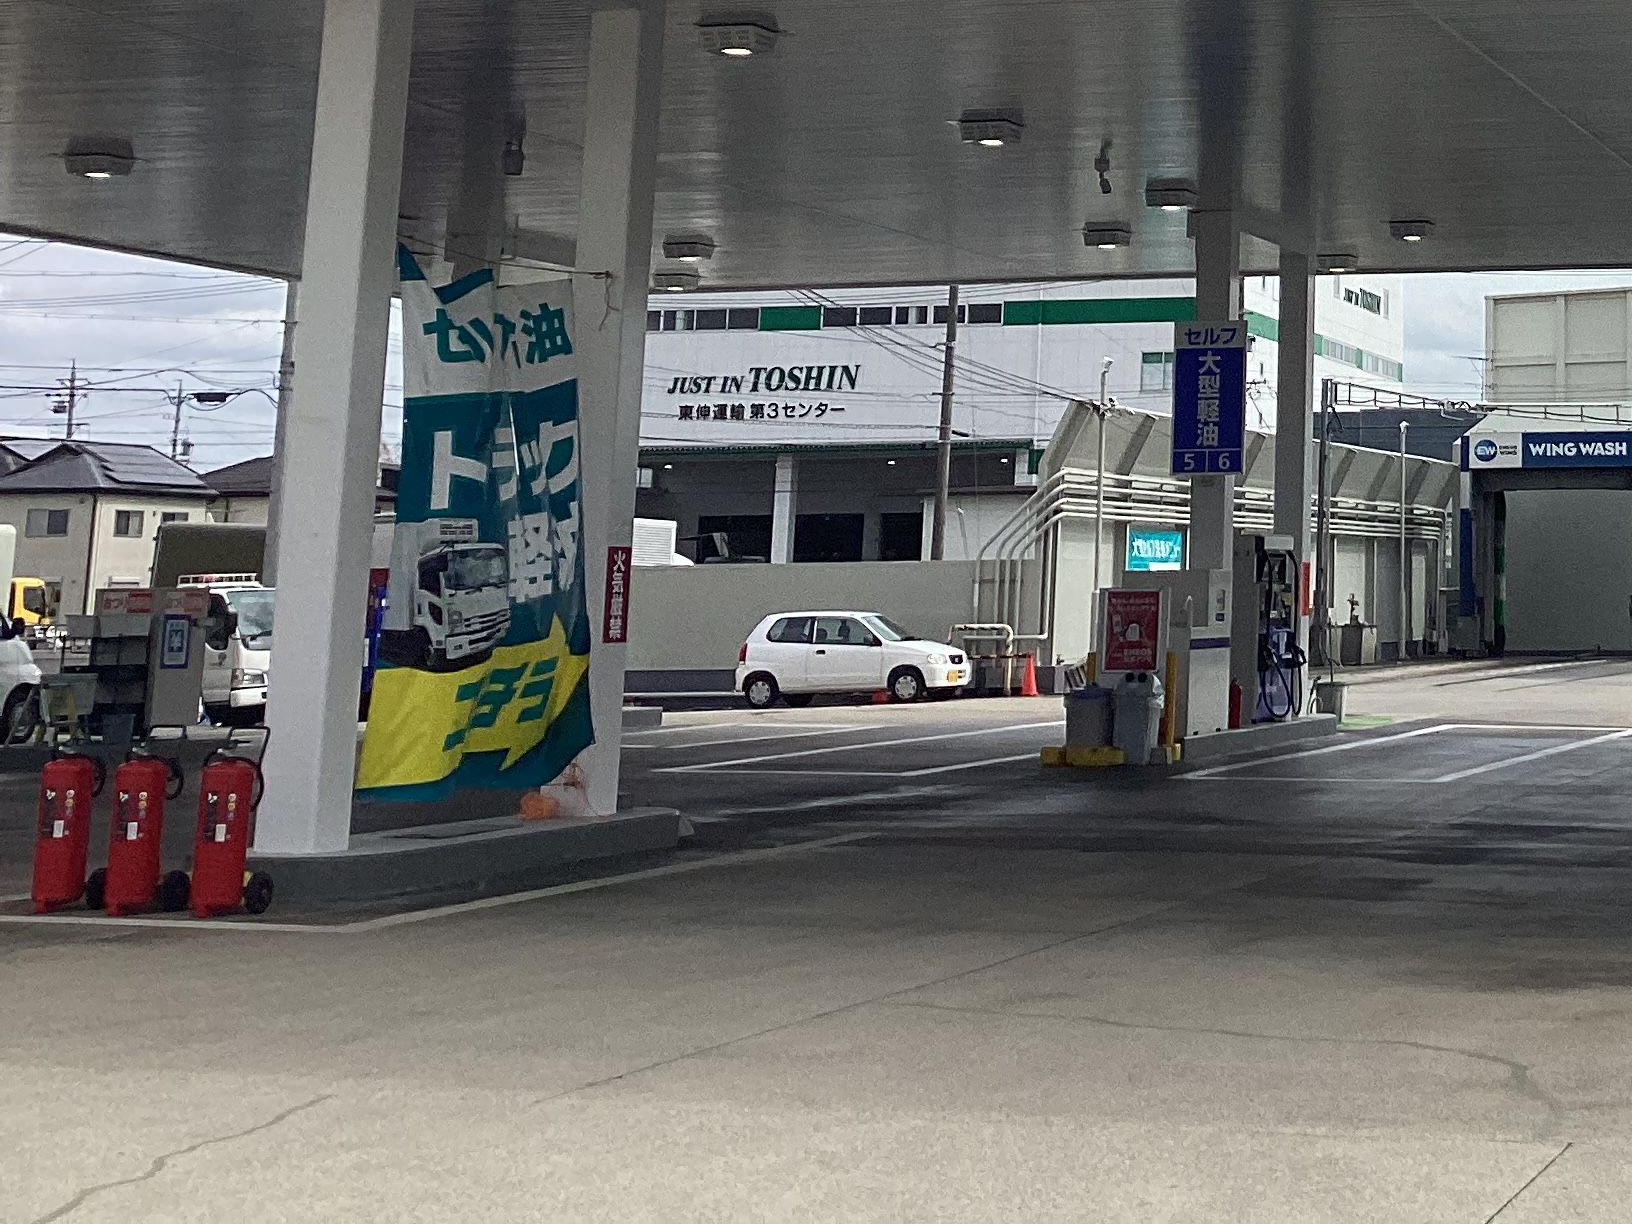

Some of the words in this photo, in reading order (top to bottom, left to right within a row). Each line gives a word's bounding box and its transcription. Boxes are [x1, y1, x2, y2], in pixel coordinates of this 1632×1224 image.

[1184, 327, 1237, 346] セルフ
[667, 376, 717, 394] JUST
[719, 376, 745, 393] IN
[749, 364, 861, 393] TOSHIN
[1196, 350, 1221, 447] 大型軽油
[749, 402, 845, 420] 第3センター
[1528, 442, 1578, 457] WING
[1579, 442, 1627, 457] WASH
[1184, 453, 1195, 470] 5
[1218, 453, 1230, 470] 6
